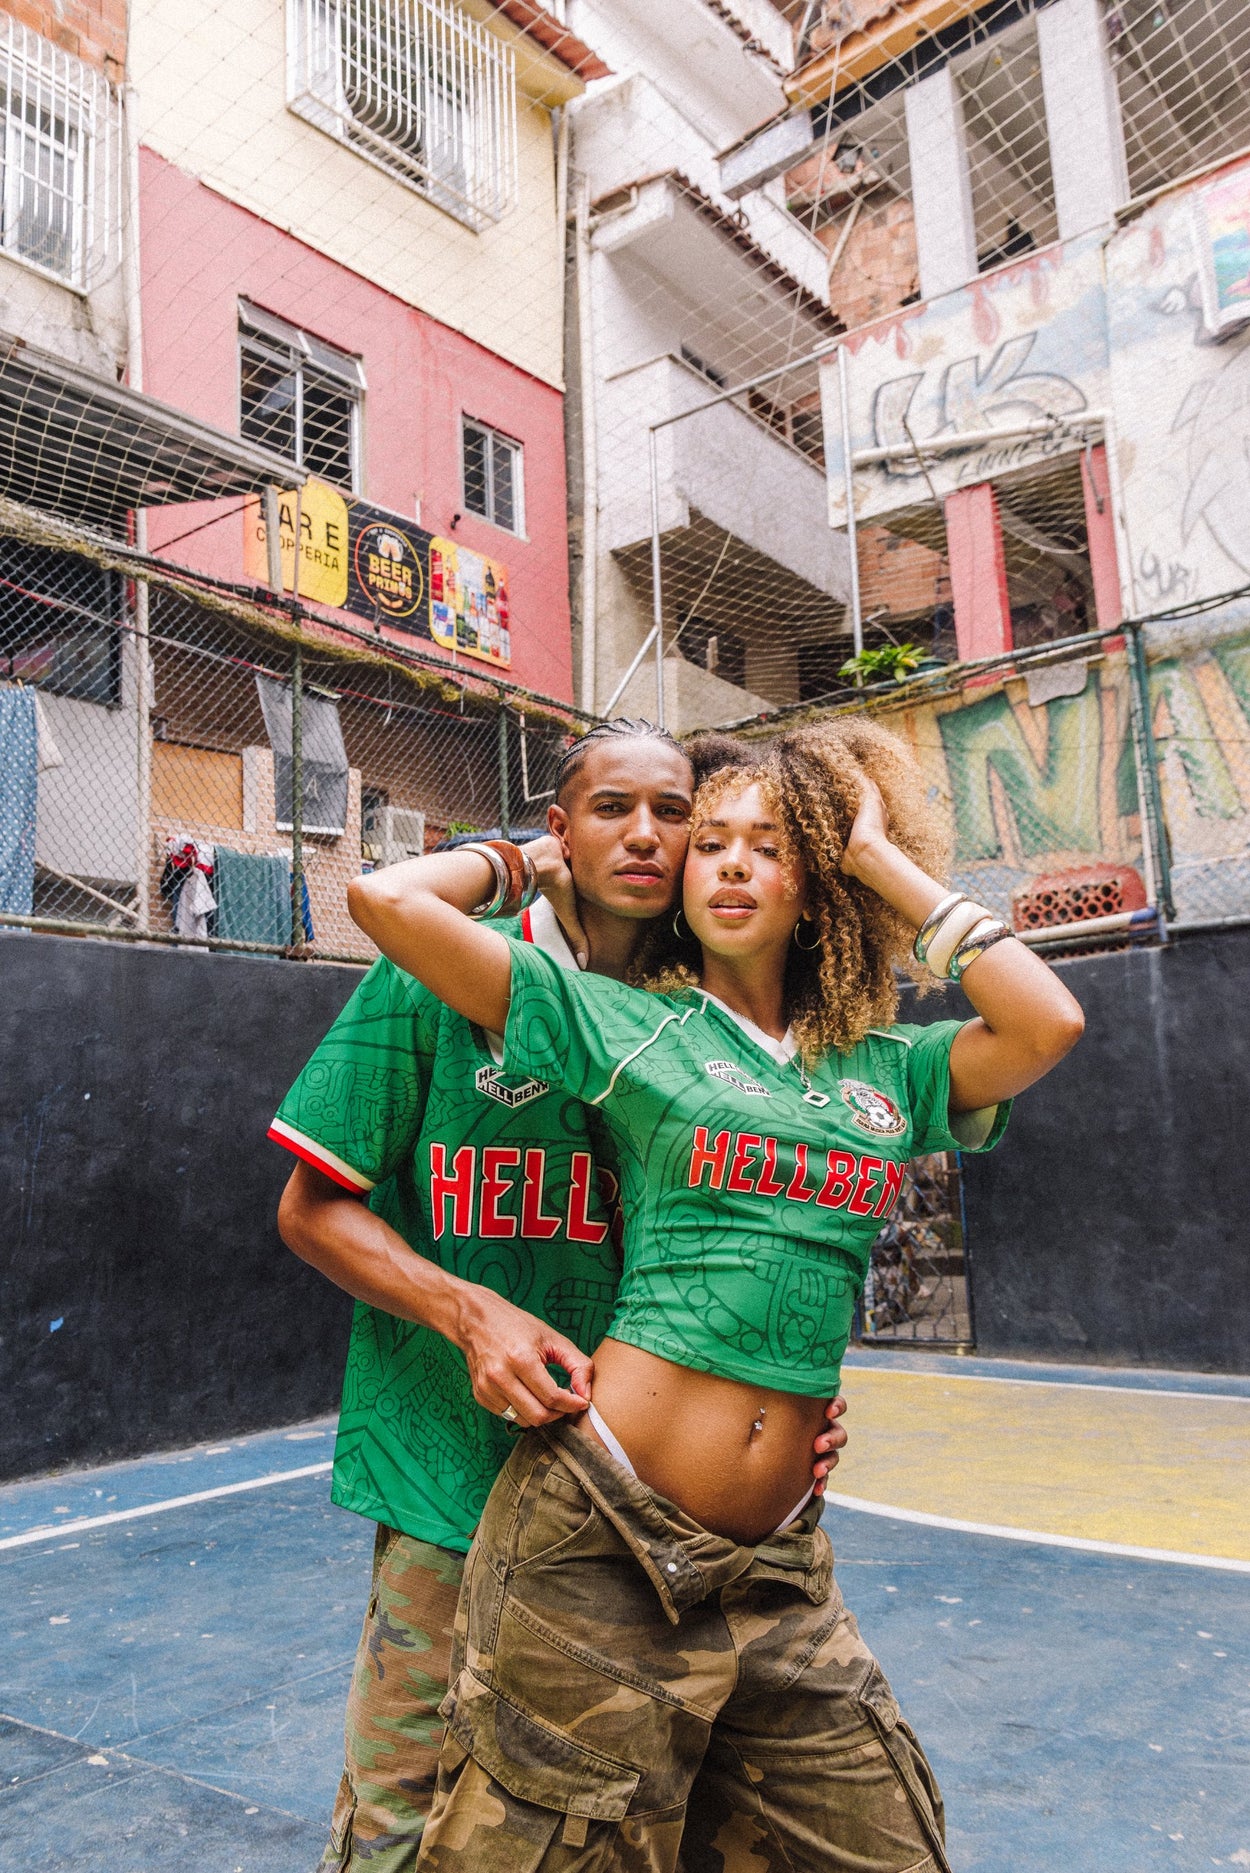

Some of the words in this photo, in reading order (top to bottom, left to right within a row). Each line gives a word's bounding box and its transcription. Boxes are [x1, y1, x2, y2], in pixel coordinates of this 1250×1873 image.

[258, 503, 312, 540] AR
[325, 521, 340, 551] E
[368, 552, 413, 587] BEER
[478, 1067, 497, 1084] HE
[430, 1142, 620, 1245] HELL
[688, 1125, 908, 1219] HELLBEN
